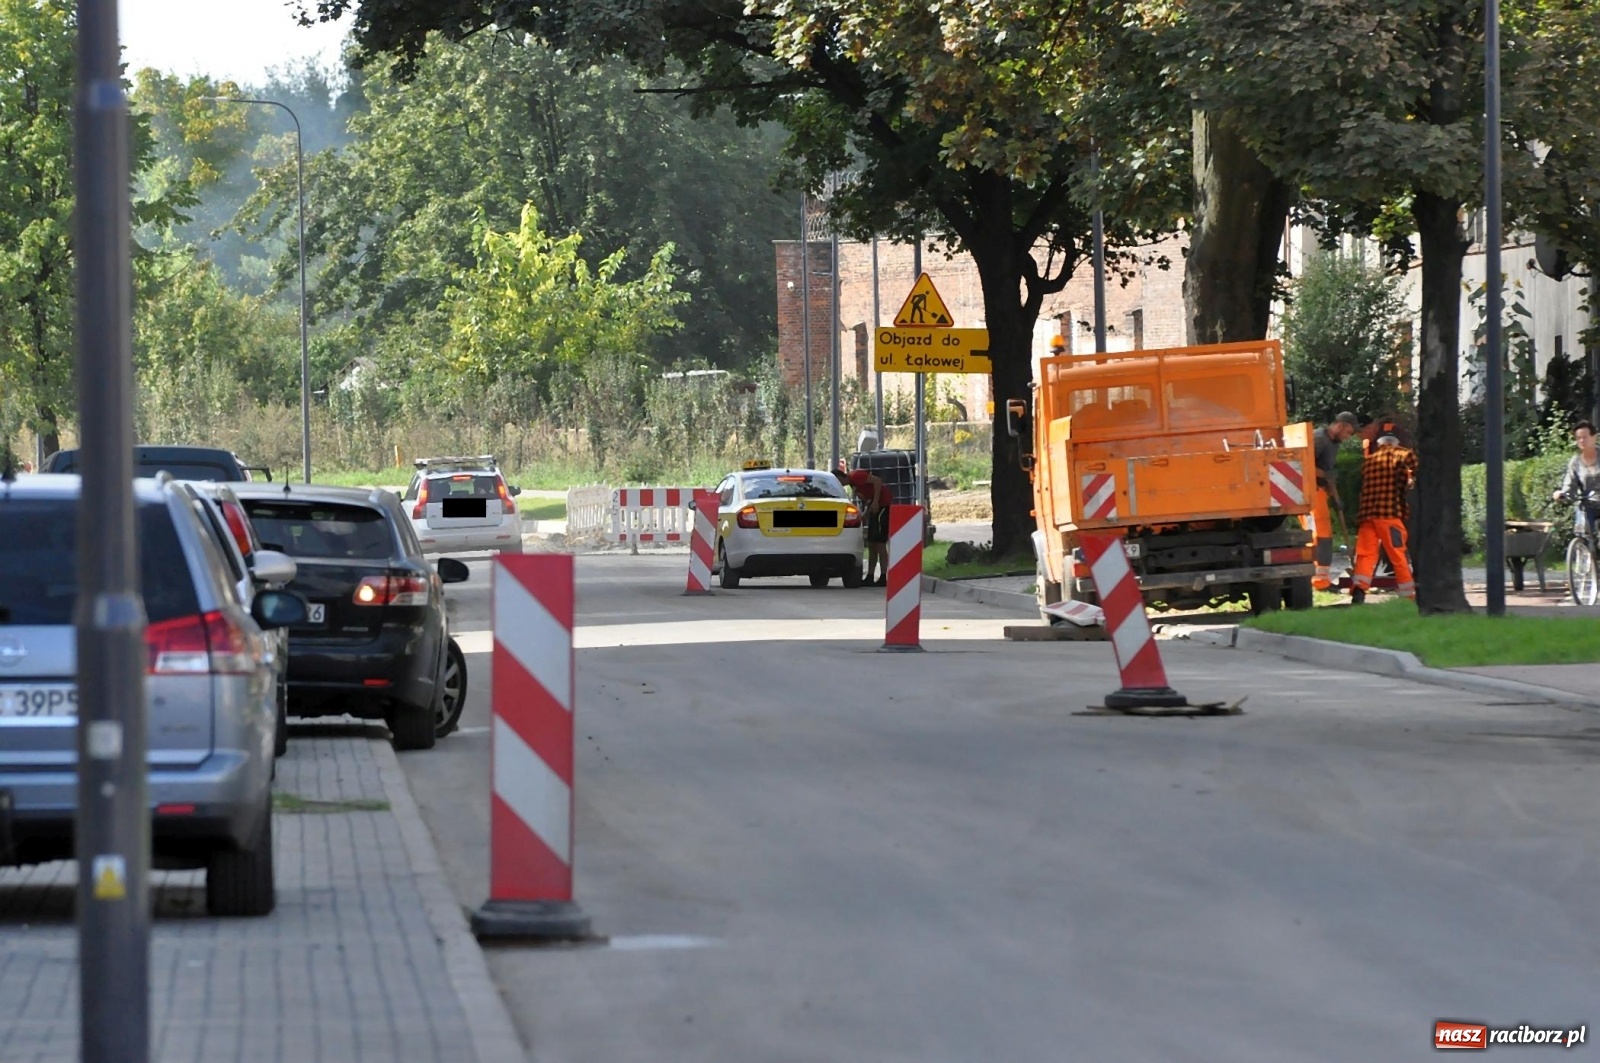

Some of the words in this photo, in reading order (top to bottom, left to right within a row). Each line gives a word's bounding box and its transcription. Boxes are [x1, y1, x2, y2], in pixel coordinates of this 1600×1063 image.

[879, 332, 932, 348] Objazd
[941, 334, 961, 346] do
[880, 353, 896, 365] ul.
